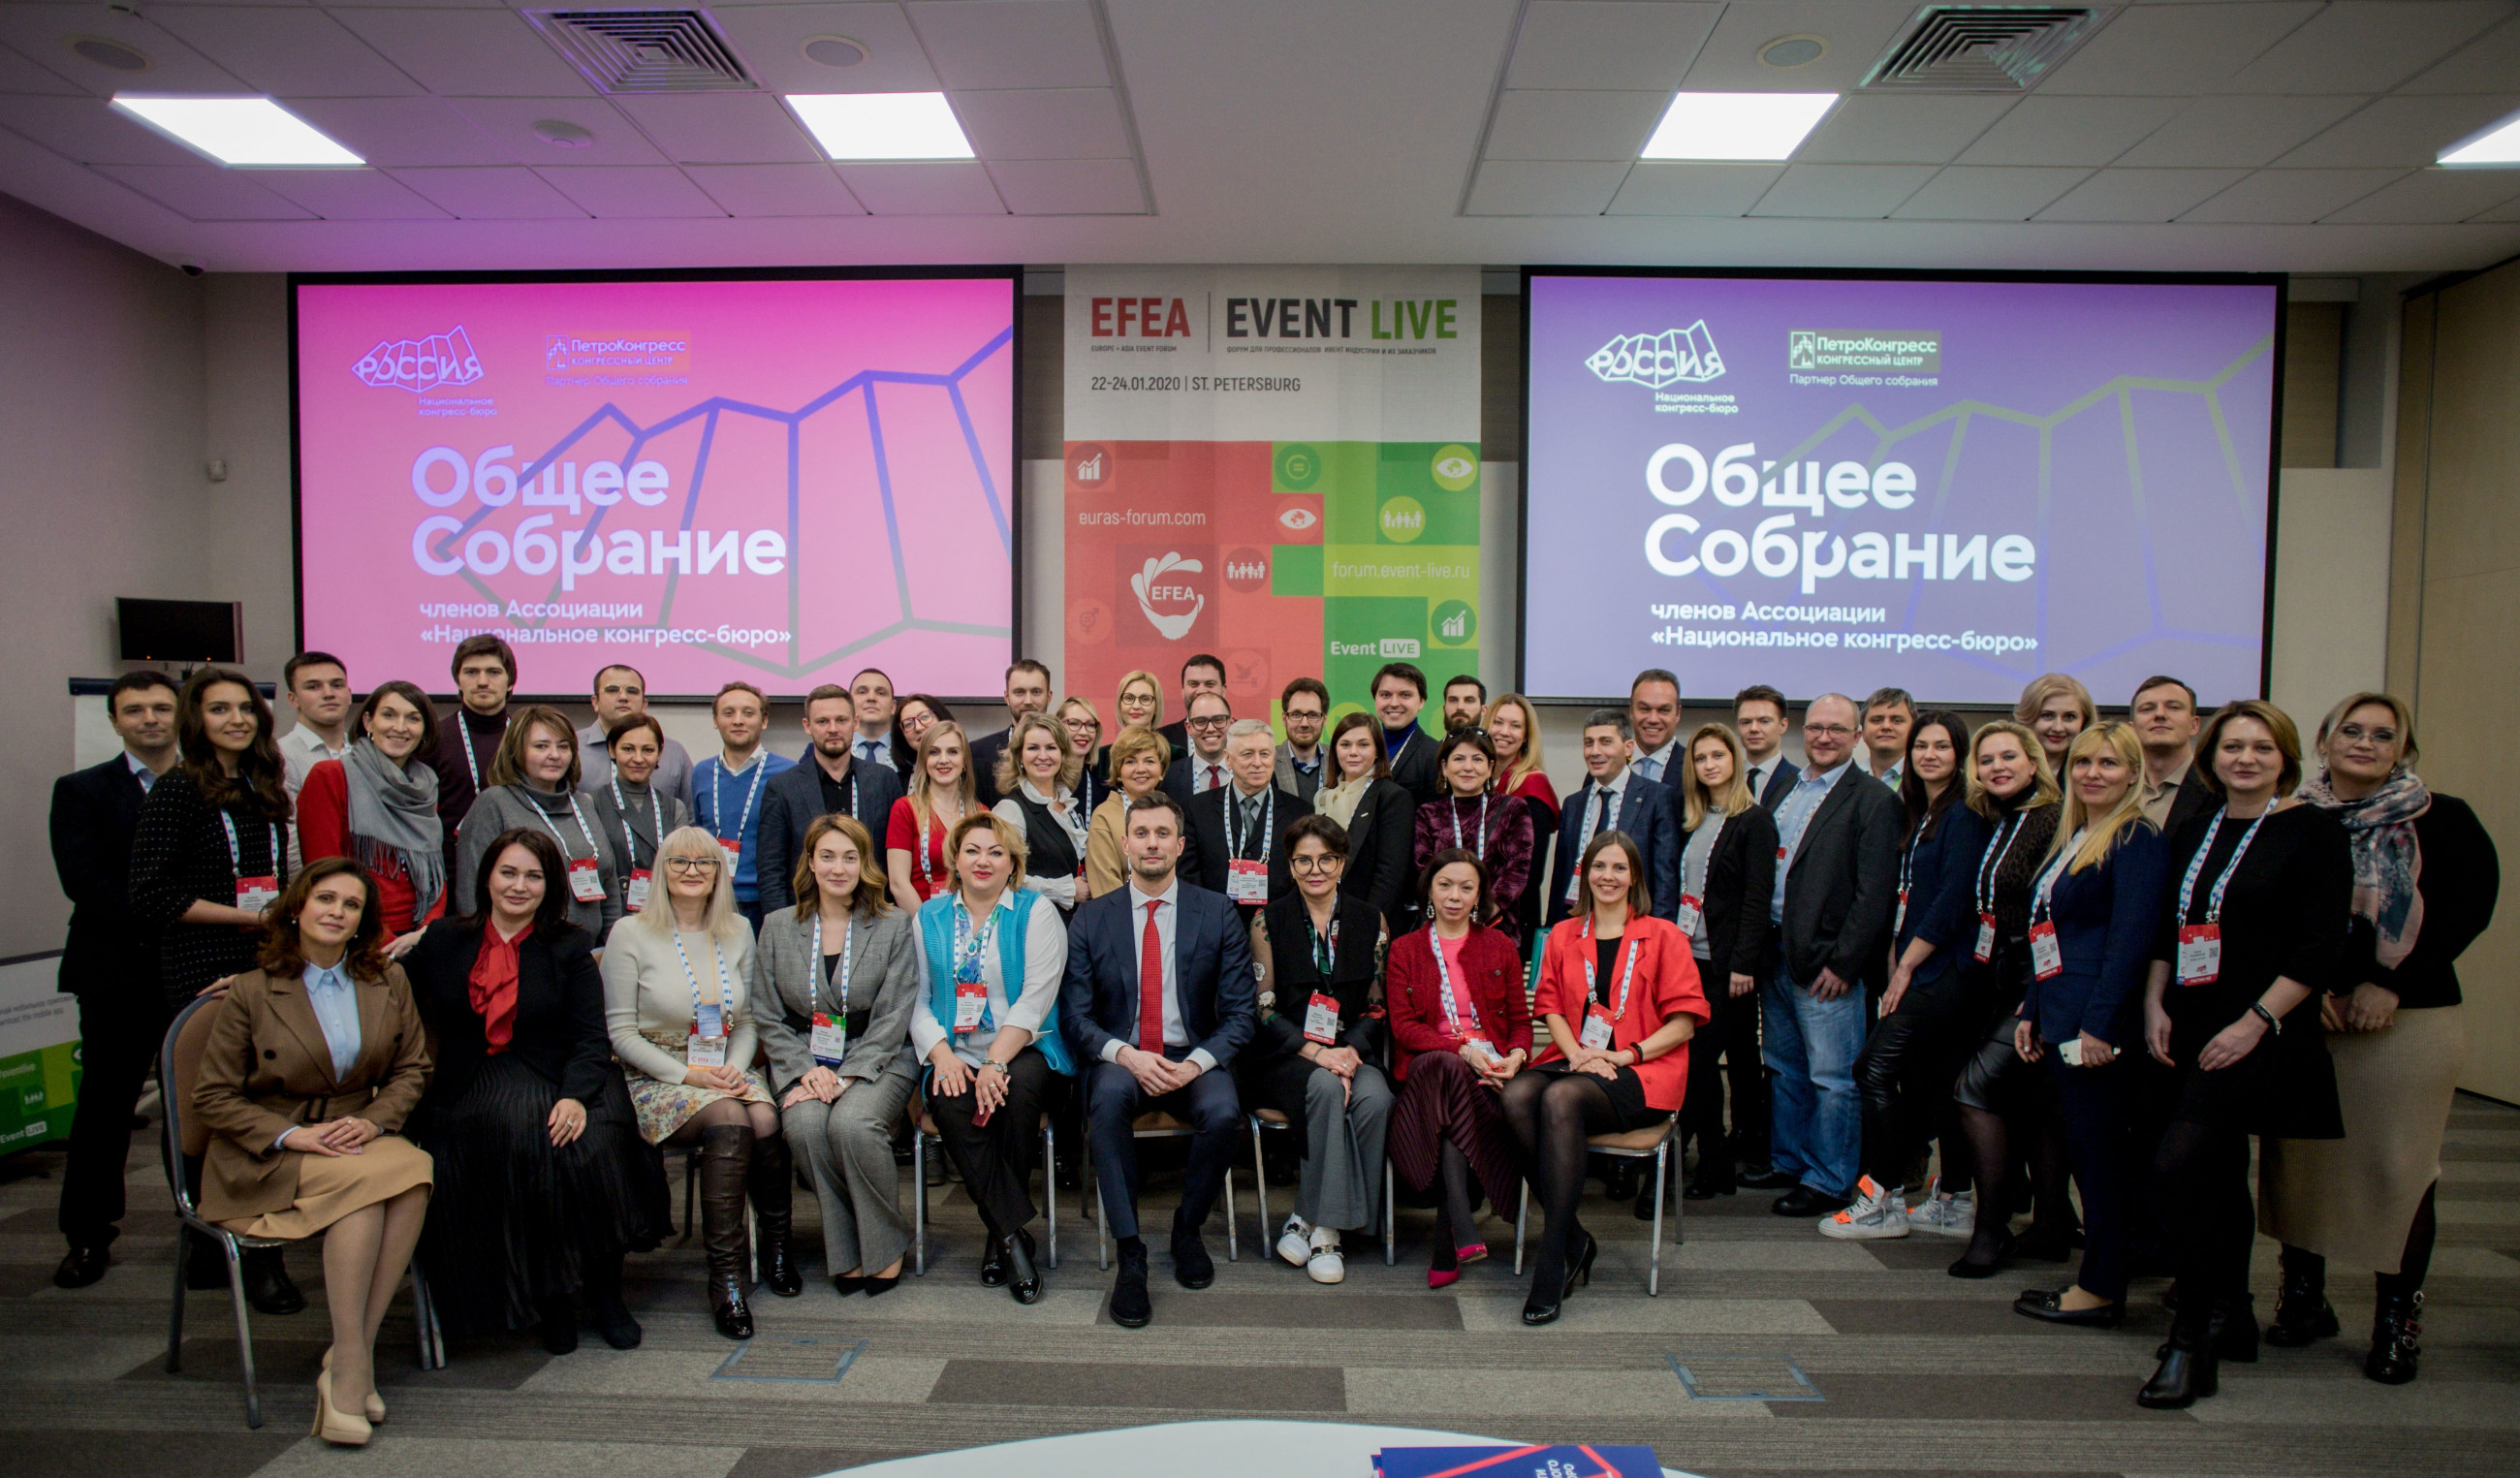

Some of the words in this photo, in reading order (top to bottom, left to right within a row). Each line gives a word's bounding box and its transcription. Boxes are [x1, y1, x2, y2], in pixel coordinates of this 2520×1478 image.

[1090, 297, 1191, 338] EFEA
[1226, 298, 1358, 338] EVENT
[1370, 299, 1459, 340] LIVE
[571, 338, 686, 355] ПетроКонгресс
[1817, 337, 1937, 355] ПетроКонгресс
[571, 355, 643, 365] КОНГРЕССНЫЙ
[645, 356, 674, 366] ЦЕНТР
[1817, 354, 1891, 365] КОНГРЕССНЫЙ
[1893, 357, 1923, 366] ЦЕНТР
[545, 375, 590, 388] Партнер
[593, 375, 634, 386] Общего
[637, 375, 688, 387] собрания
[1091, 376, 1181, 391] 22-24.01.2020
[1192, 377, 1210, 391] ST.
[1213, 377, 1301, 392] PETERSBURG
[1790, 374, 1836, 386] Партнер
[1840, 375, 1882, 386] Общего
[1885, 376, 1938, 388] собрания
[419, 397, 493, 407] Национальное
[1655, 393, 1735, 403] Национальное
[419, 407, 497, 417] конгресс-бюро
[1655, 402, 1739, 415] конгресс-бюро
[412, 444, 670, 515] Общее
[1646, 442, 1916, 517] Общее
[1079, 508, 1206, 526] euras-forum.com
[412, 514, 786, 591] Собрание
[1645, 514, 2035, 594] Собрание
[1333, 560, 1469, 579] forum.event-live.ru
[1151, 586, 1195, 601] EFEA
[420, 602, 500, 618] членов
[505, 599, 643, 620] Ассоциации
[1651, 604, 1736, 620] членов
[1741, 601, 1885, 624] Ассоциации
[604, 624, 792, 648] конгресс-бюро»
[1651, 626, 1839, 648] «Национальное
[1843, 630, 2038, 655] конгресс-бюро»
[1331, 641, 1375, 656] Event
[1383, 641, 1415, 654] LIVE
[0, 1129, 25, 1143] Event
[27, 1123, 46, 1135] LIVE
